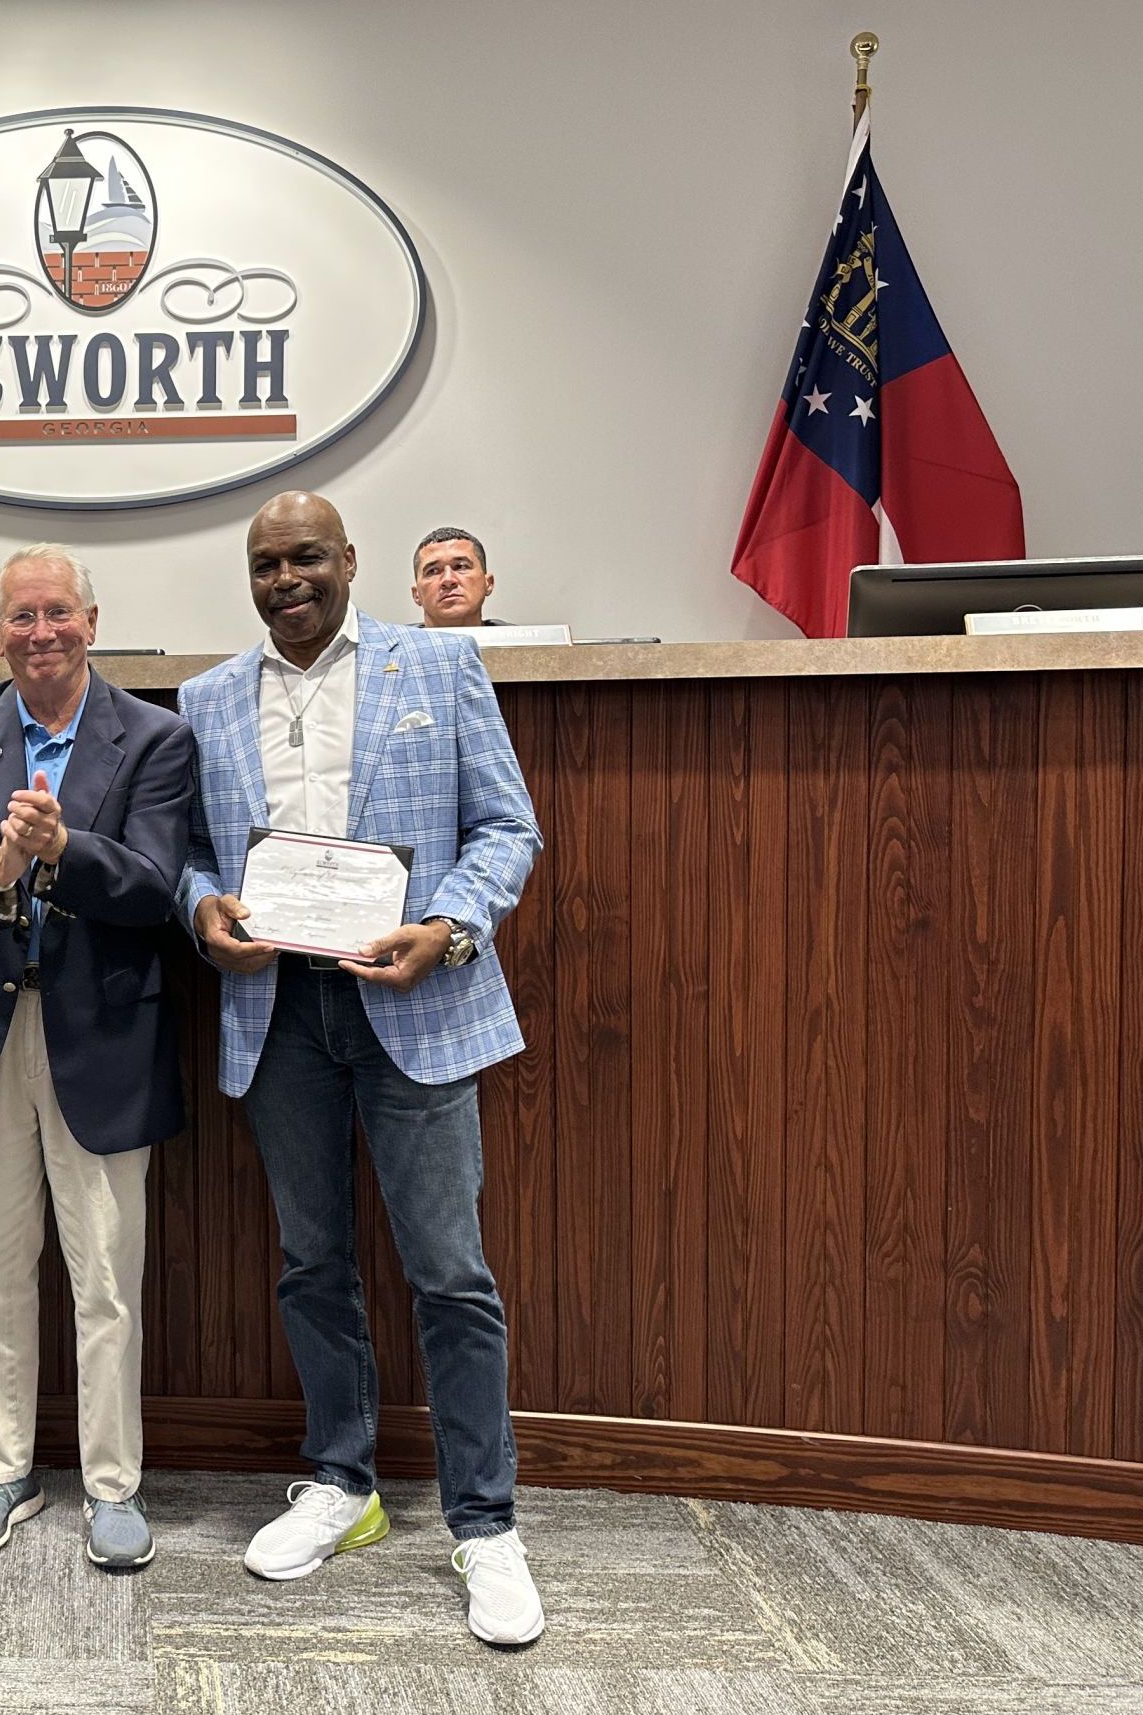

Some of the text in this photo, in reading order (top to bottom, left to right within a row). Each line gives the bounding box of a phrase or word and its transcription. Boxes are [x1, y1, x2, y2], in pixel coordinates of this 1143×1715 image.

[101, 282, 127, 292] 1860
[827, 336, 877, 387] WE TRUST
[42, 421, 149, 435] GEORGIA
